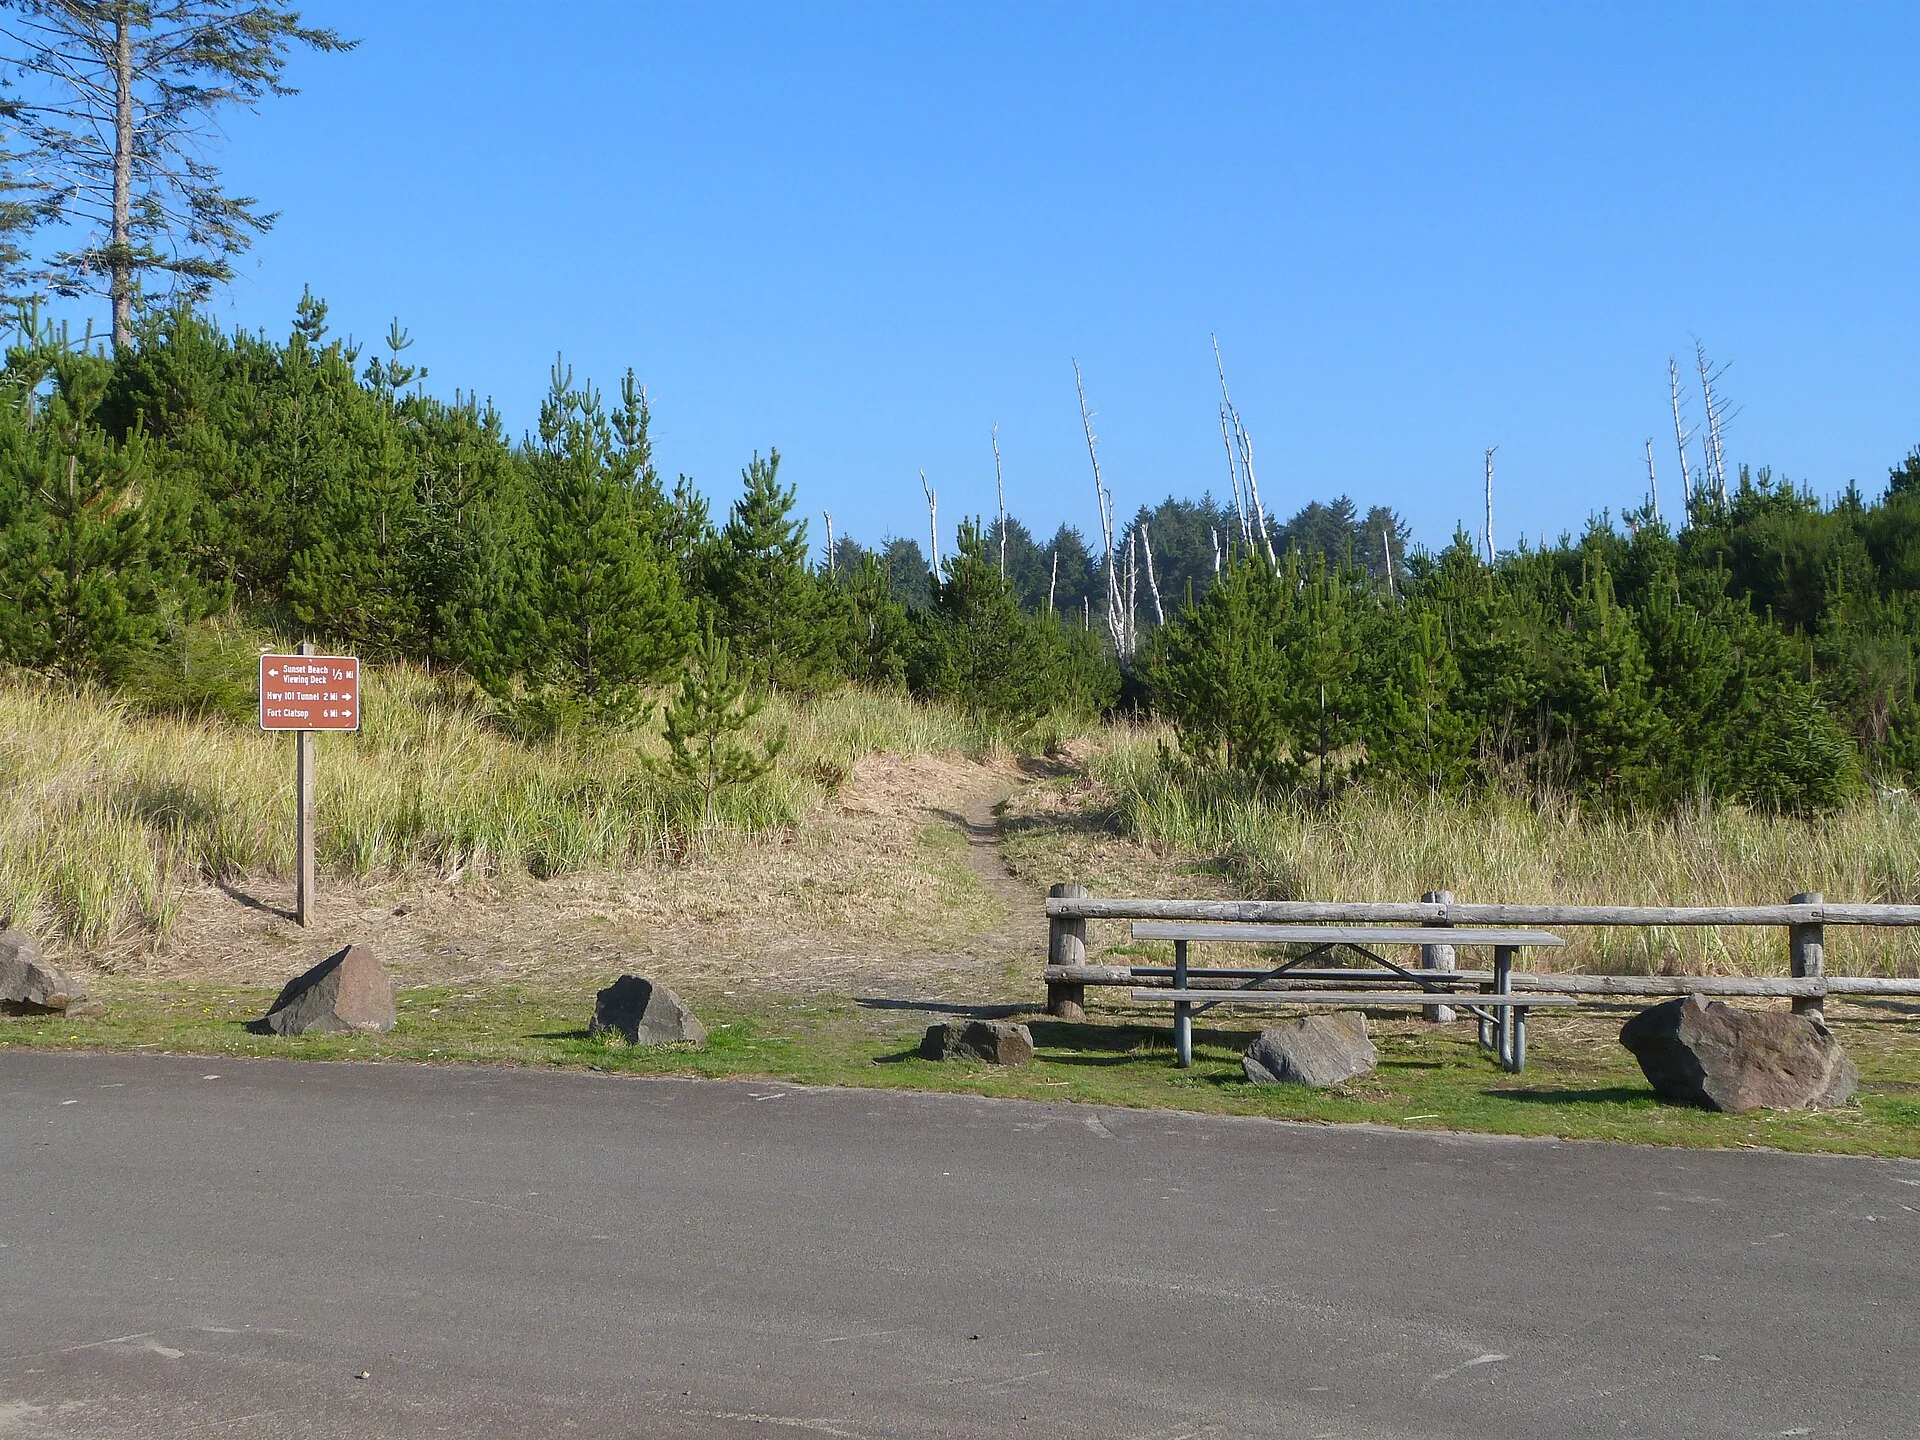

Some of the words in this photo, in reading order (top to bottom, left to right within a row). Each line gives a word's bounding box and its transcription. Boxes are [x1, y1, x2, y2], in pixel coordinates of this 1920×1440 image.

[283, 665, 306, 673] Sunset
[307, 665, 329, 674] Beach
[283, 675, 309, 685] Viewing
[310, 675, 327, 684] Deck
[345, 671, 354, 679] Mi
[267, 691, 282, 702] Hwy
[284, 692, 295, 700] 101
[296, 692, 320, 700] Tunnel
[323, 692, 328, 700] 2
[330, 692, 338, 700] Mi
[267, 708, 281, 717] Fort
[283, 709, 309, 719] Clatsop
[323, 709, 328, 717] 6
[330, 709, 338, 717] Mi
